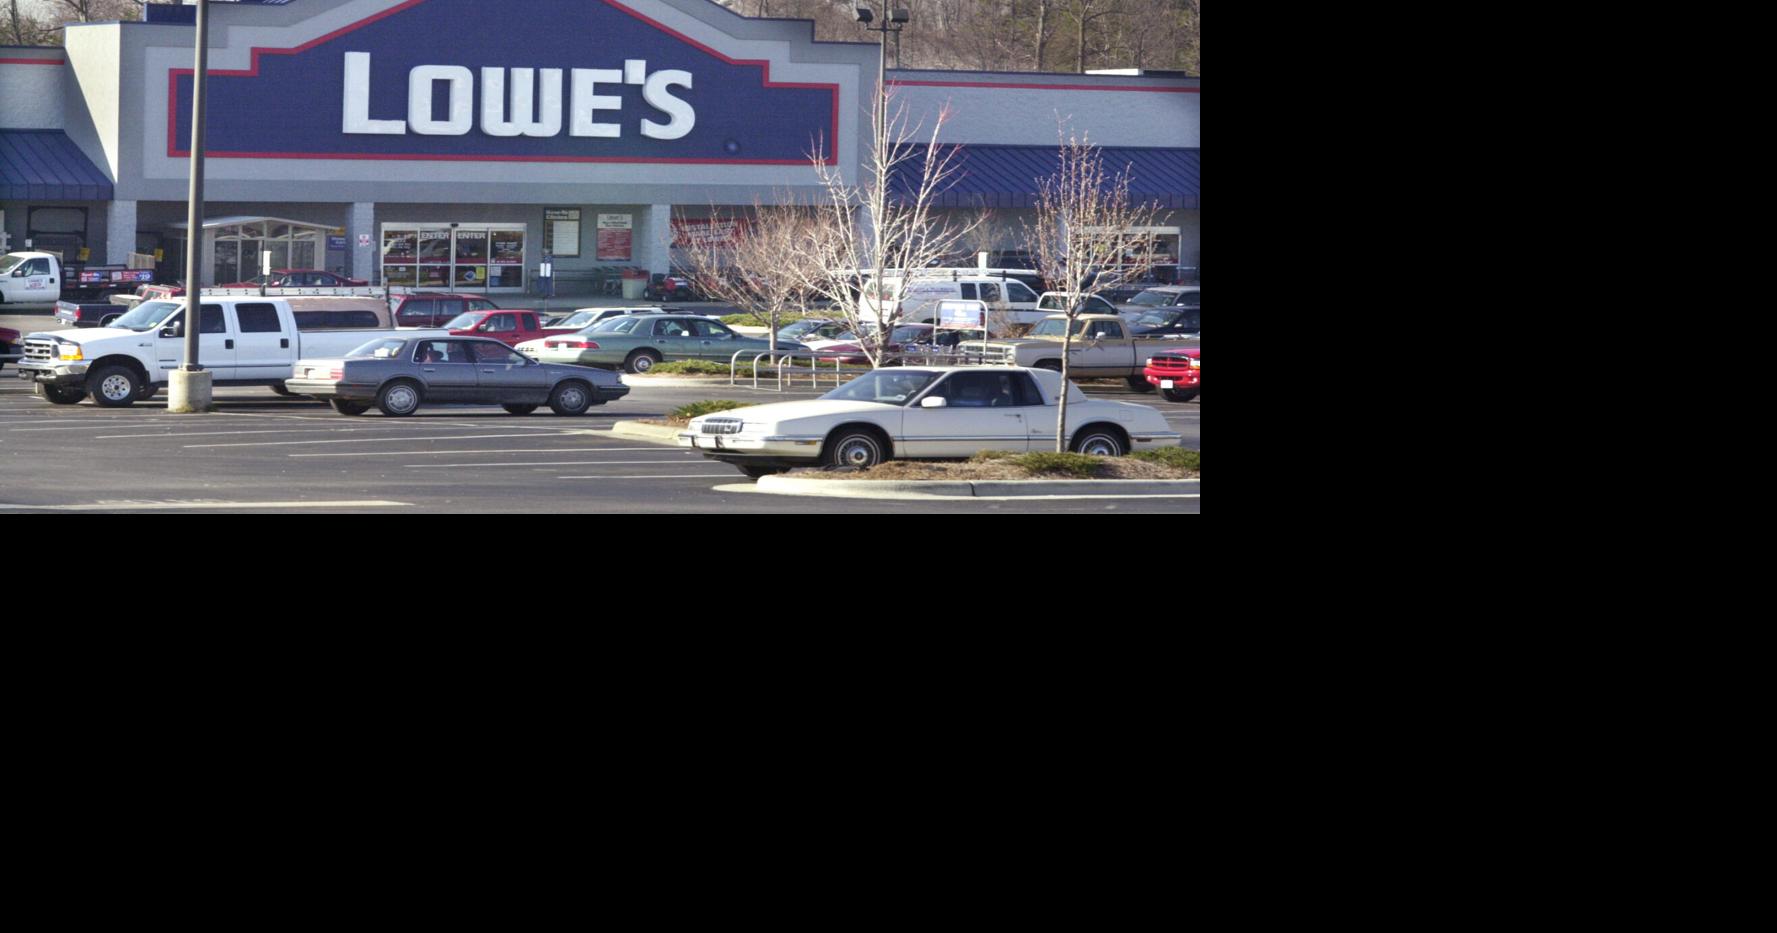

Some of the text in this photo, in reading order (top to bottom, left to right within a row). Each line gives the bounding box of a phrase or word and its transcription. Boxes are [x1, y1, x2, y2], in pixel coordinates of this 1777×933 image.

[342, 51, 696, 140] LOWE'S
[421, 231, 449, 240] ENTER
[457, 232, 486, 240] ENTER
